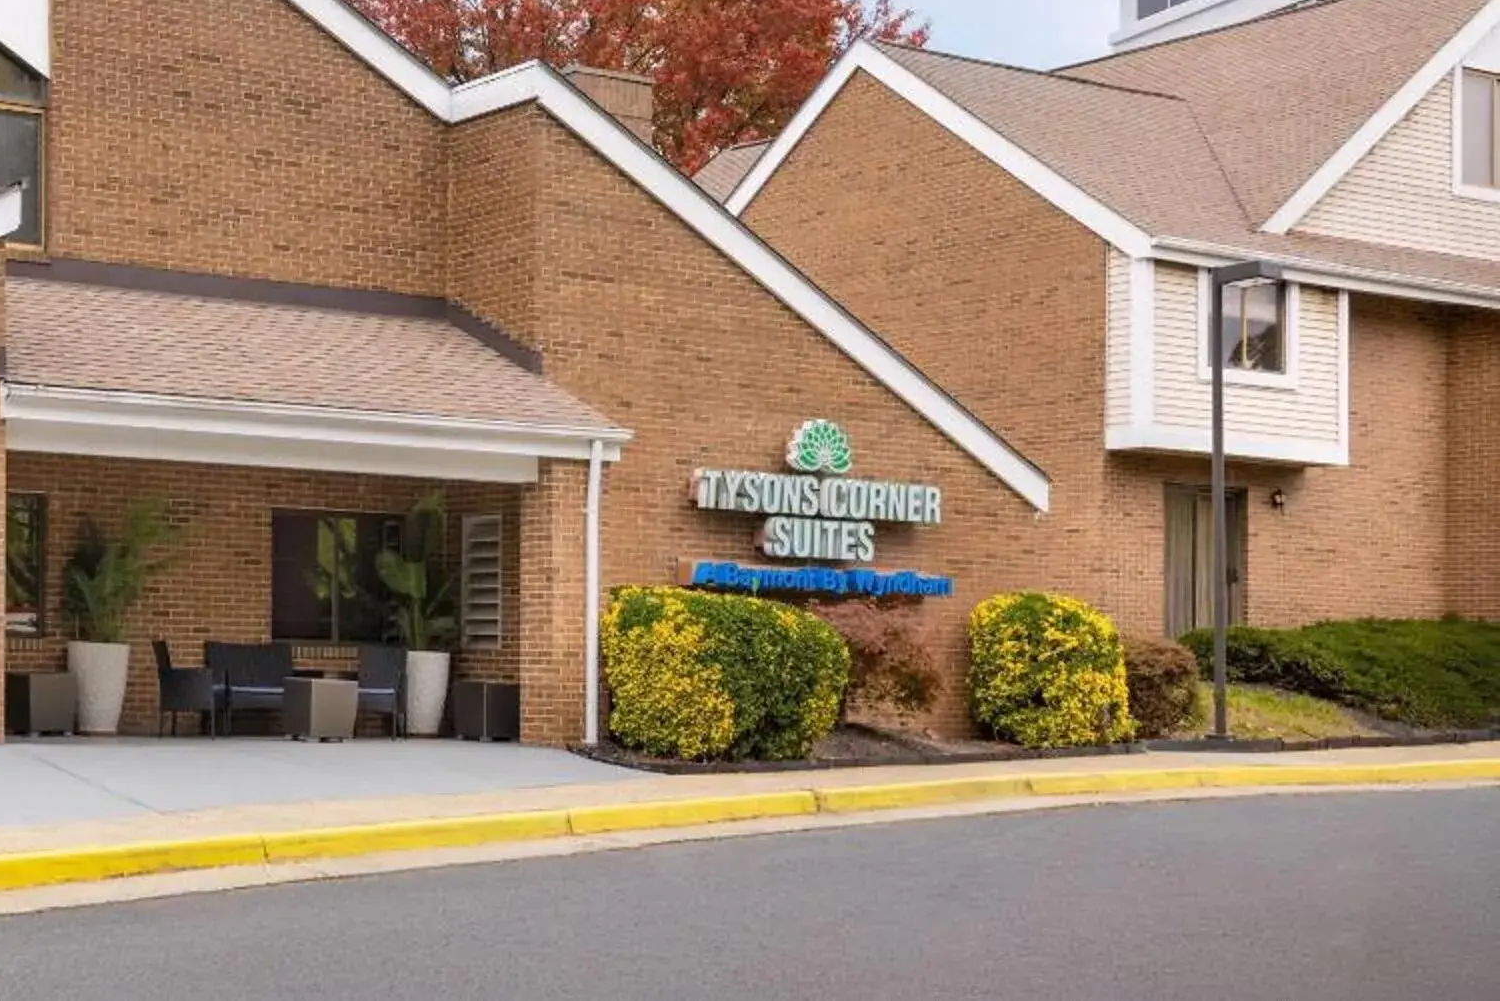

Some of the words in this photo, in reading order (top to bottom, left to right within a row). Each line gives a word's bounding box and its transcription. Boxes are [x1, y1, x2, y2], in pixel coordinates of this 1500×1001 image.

[700, 470, 819, 516] TYSONS
[829, 478, 942, 524] CORNER
[773, 517, 875, 562] SUITES
